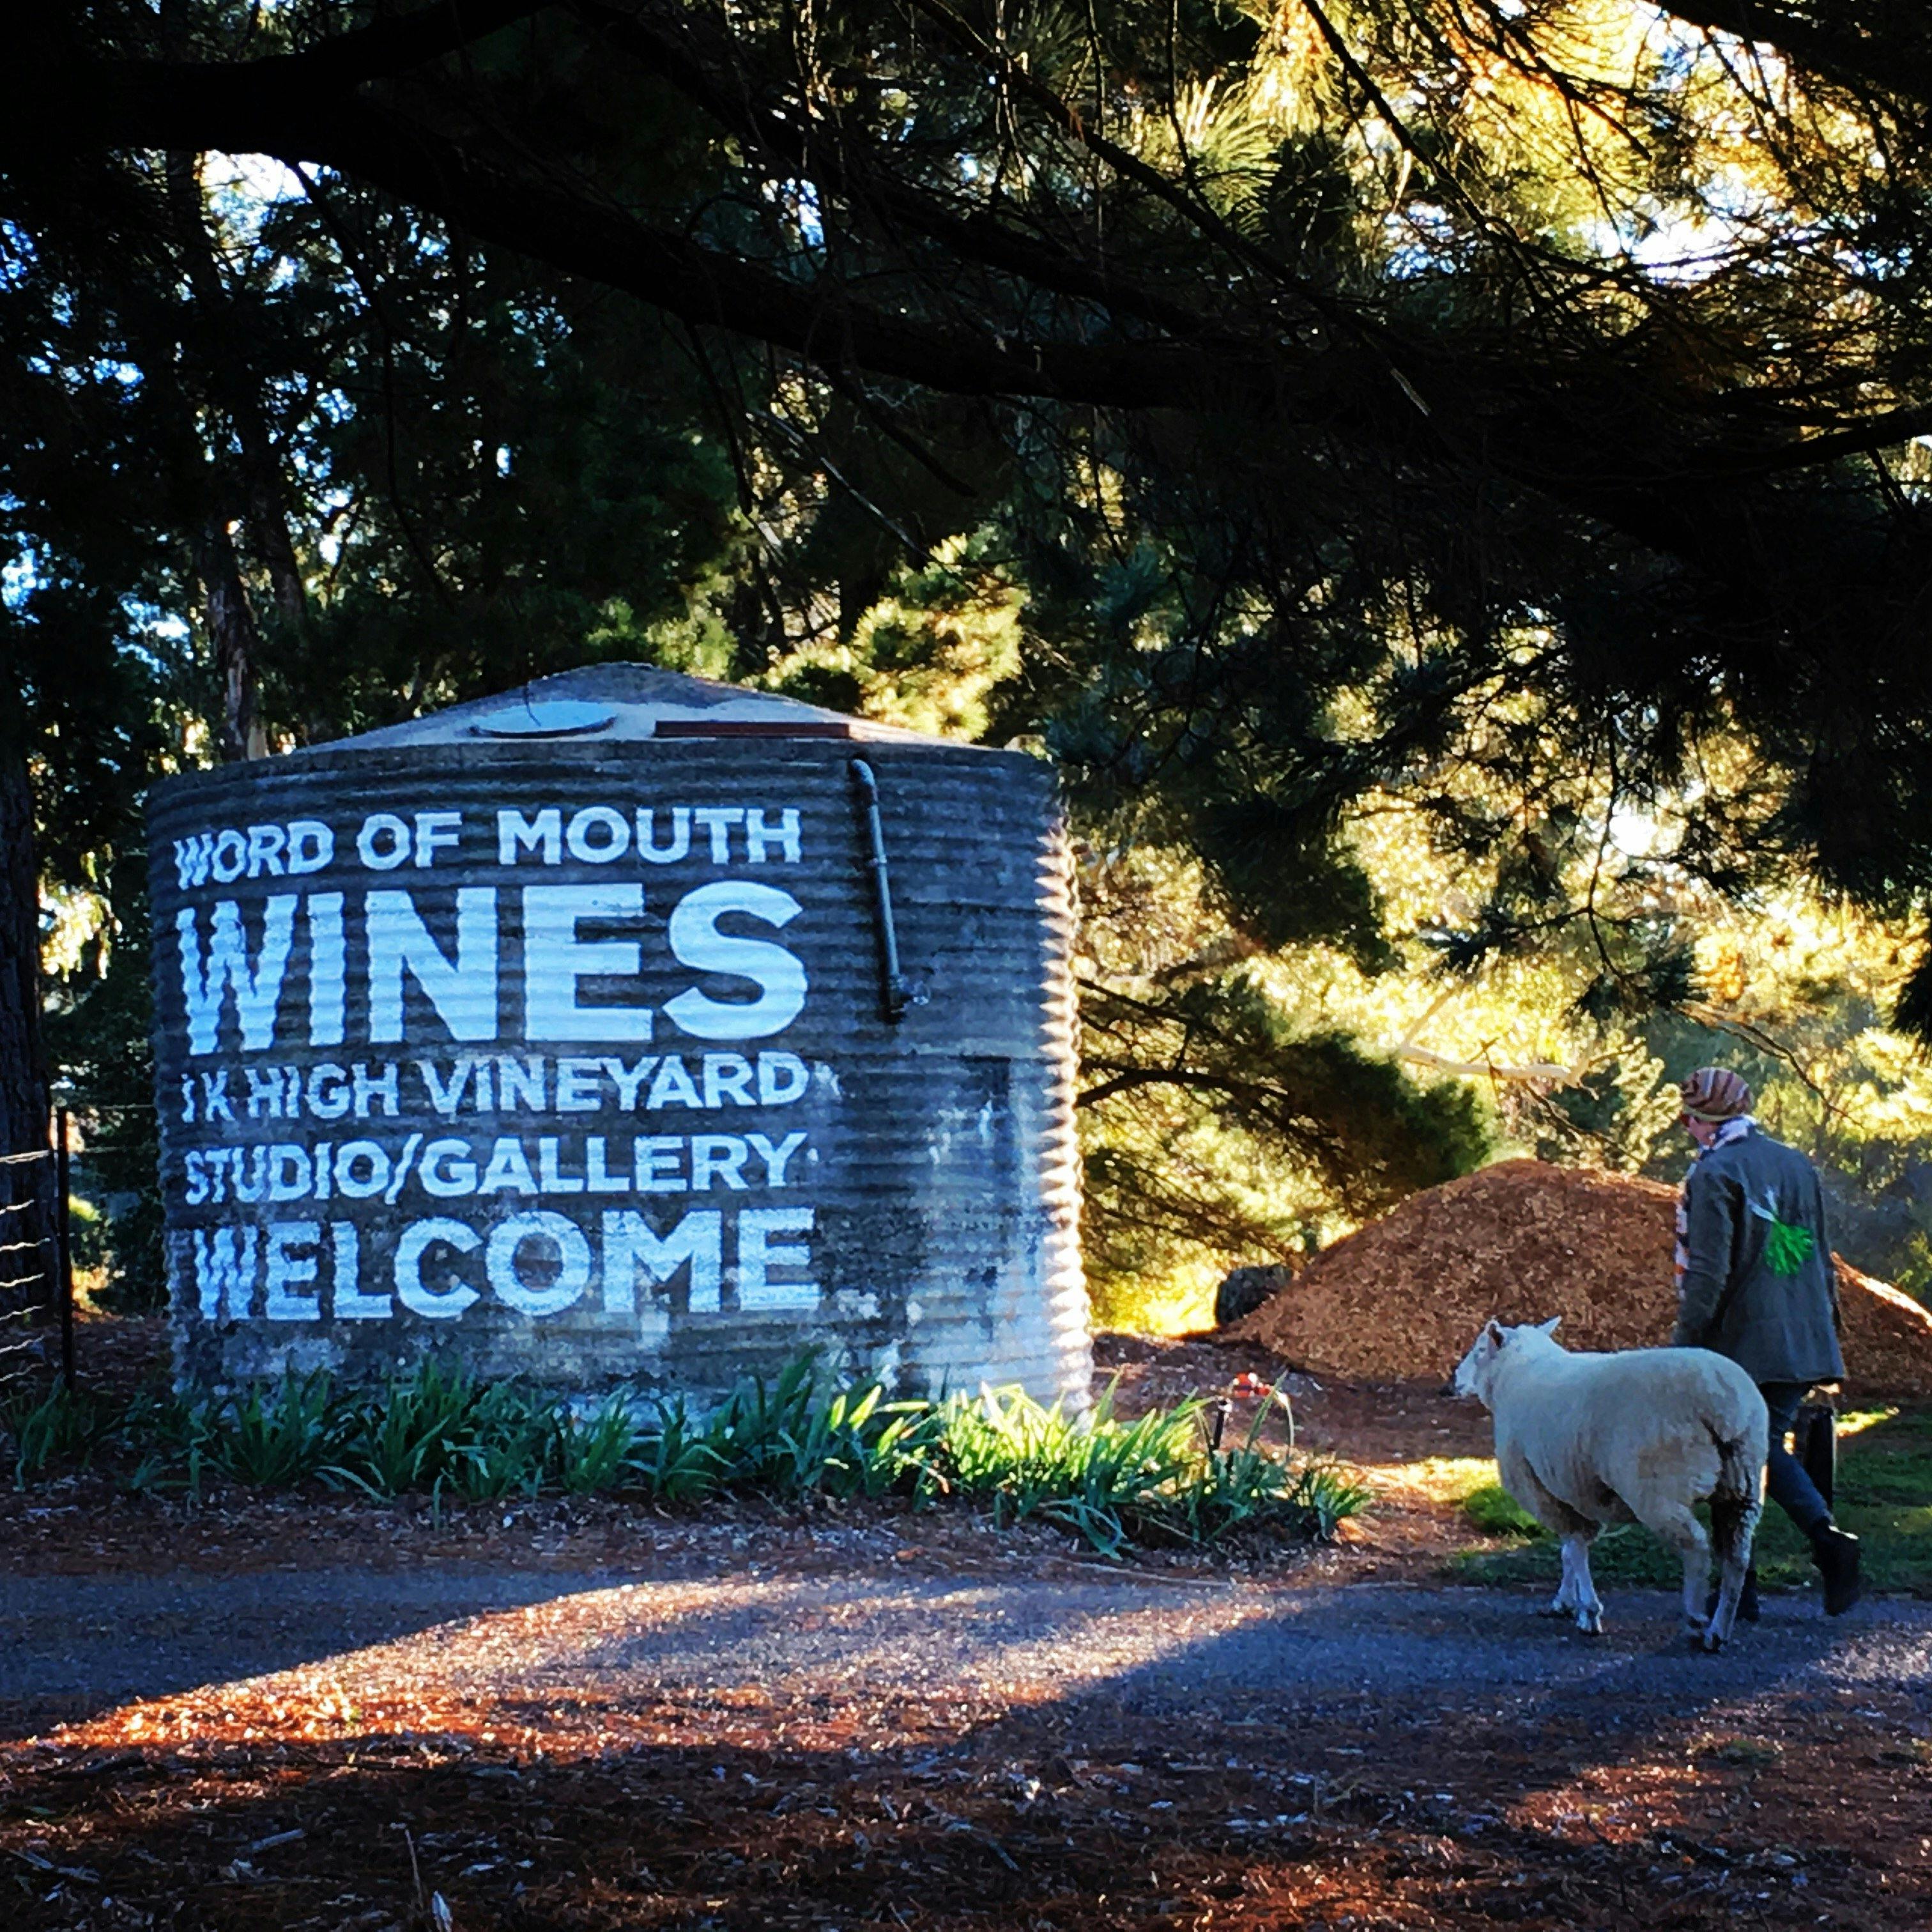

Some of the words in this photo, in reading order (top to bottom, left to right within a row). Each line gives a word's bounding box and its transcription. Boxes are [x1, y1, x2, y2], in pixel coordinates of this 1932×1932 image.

[173, 820, 335, 889] WORD
[356, 812, 462, 870] OF
[496, 806, 801, 866] MOUTH
[176, 880, 808, 1055] WINES
[246, 1061, 401, 1119] HIGH
[416, 1052, 808, 1115] VINEYARD
[184, 1133, 808, 1206] STUDIO/GALLERY
[194, 1208, 820, 1320] WELCOME
